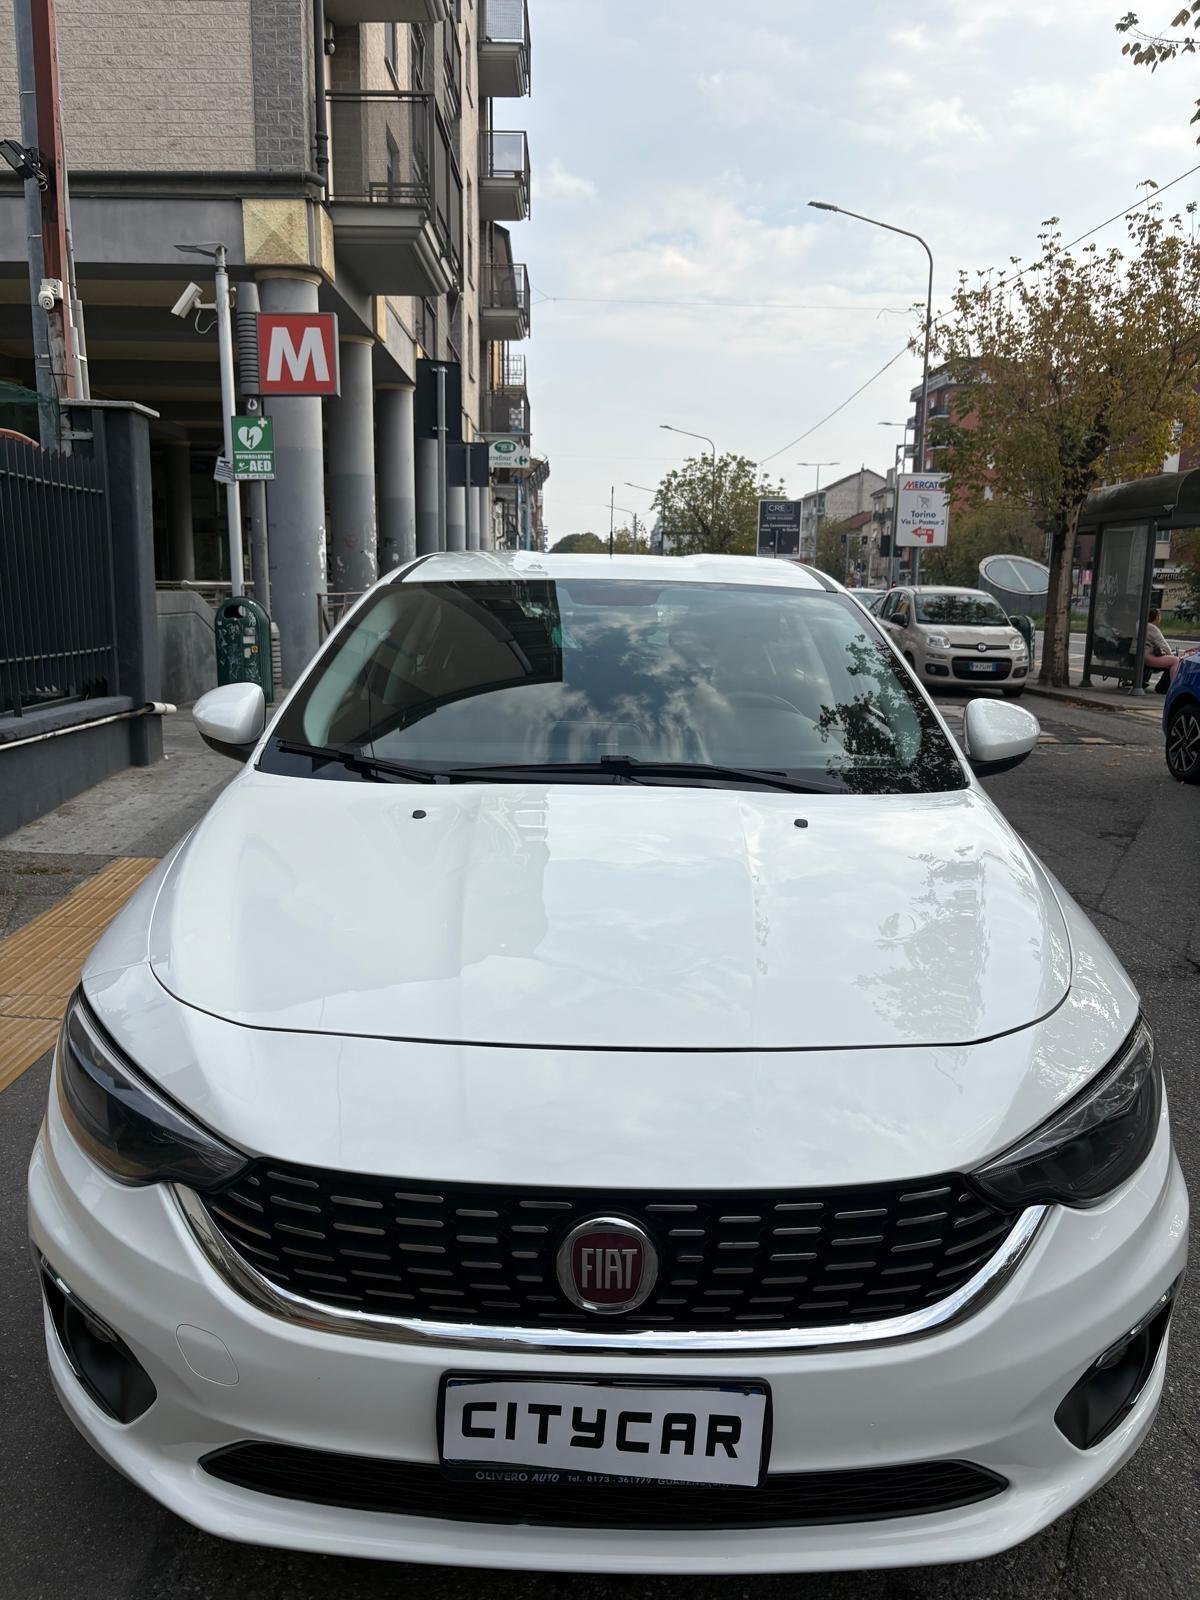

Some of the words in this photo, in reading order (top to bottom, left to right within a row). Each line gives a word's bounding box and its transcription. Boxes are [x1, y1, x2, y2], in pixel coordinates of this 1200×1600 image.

[266, 326, 330, 382] M
[249, 460, 272, 472] AED
[911, 510, 936, 518] Torino
[581, 1247, 638, 1289] FIAT
[461, 1402, 742, 1458] CITYCAR
[475, 1471, 528, 1482] OLIVERO
[531, 1473, 560, 1483] AUTO
[586, 1475, 610, 1483] 0173
